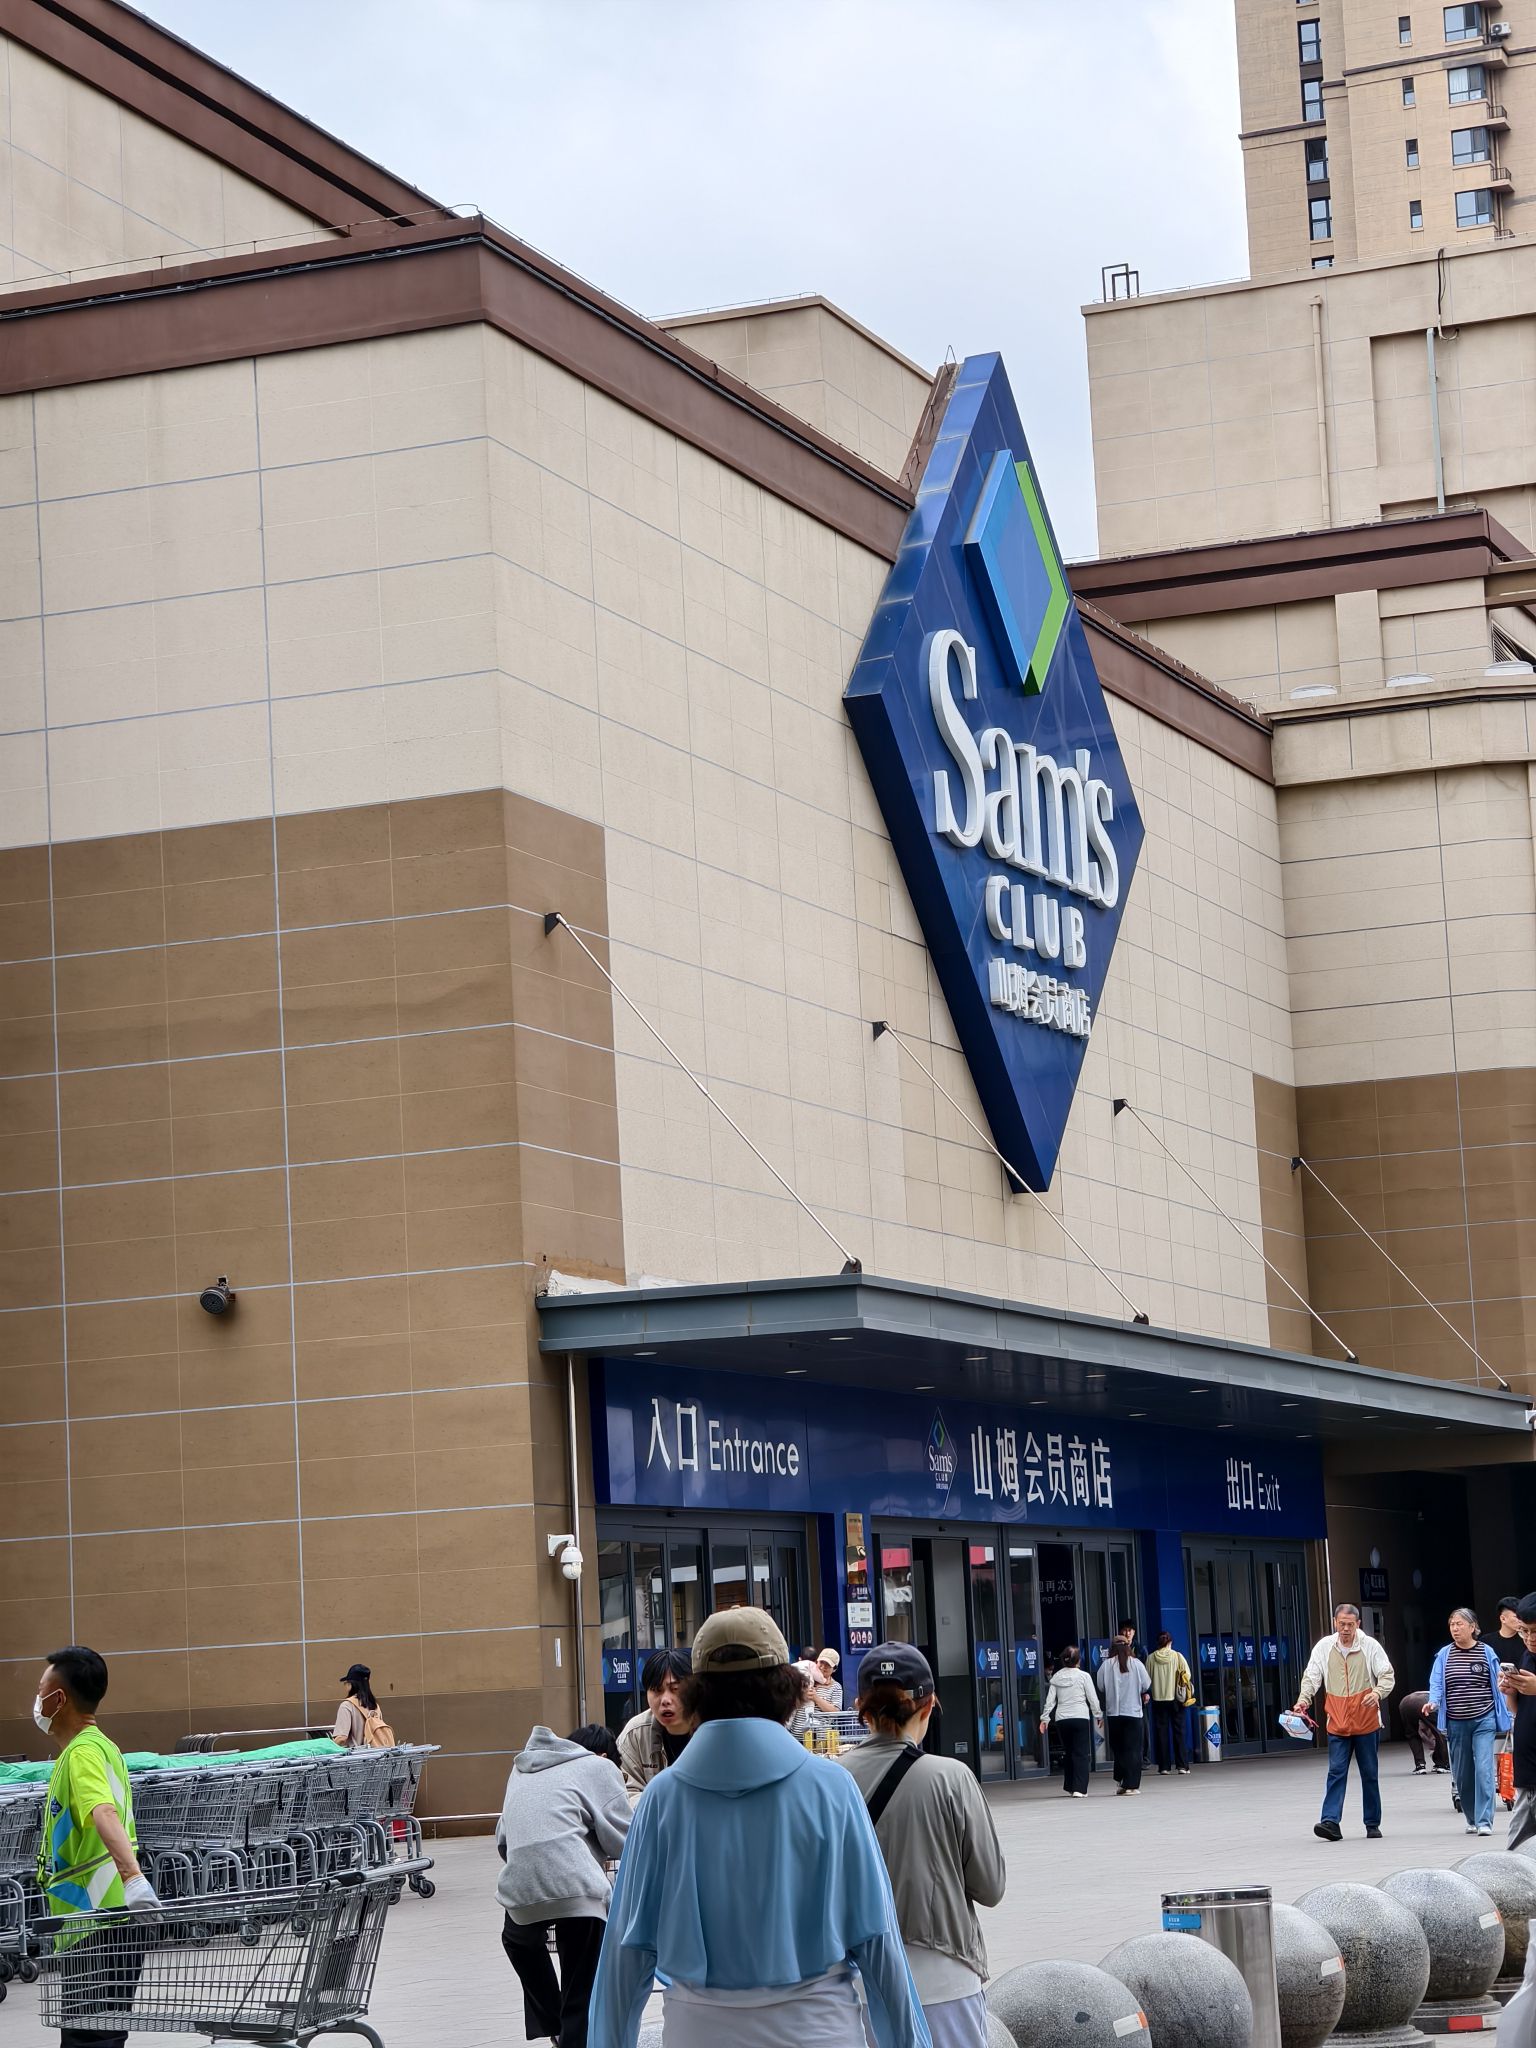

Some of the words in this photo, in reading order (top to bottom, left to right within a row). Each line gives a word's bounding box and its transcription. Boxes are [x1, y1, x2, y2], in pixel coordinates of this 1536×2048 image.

[929, 629, 1119, 908] Sam's
[986, 875, 1087, 968] CLUB
[647, 1398, 699, 1472] 入口
[709, 1420, 800, 1476] Entrance
[929, 1445, 953, 1473] Sam's
[970, 1425, 1113, 1509] 山姆会员商店
[1226, 1457, 1254, 1511] 出口
[1258, 1472, 1282, 1512] Exit
